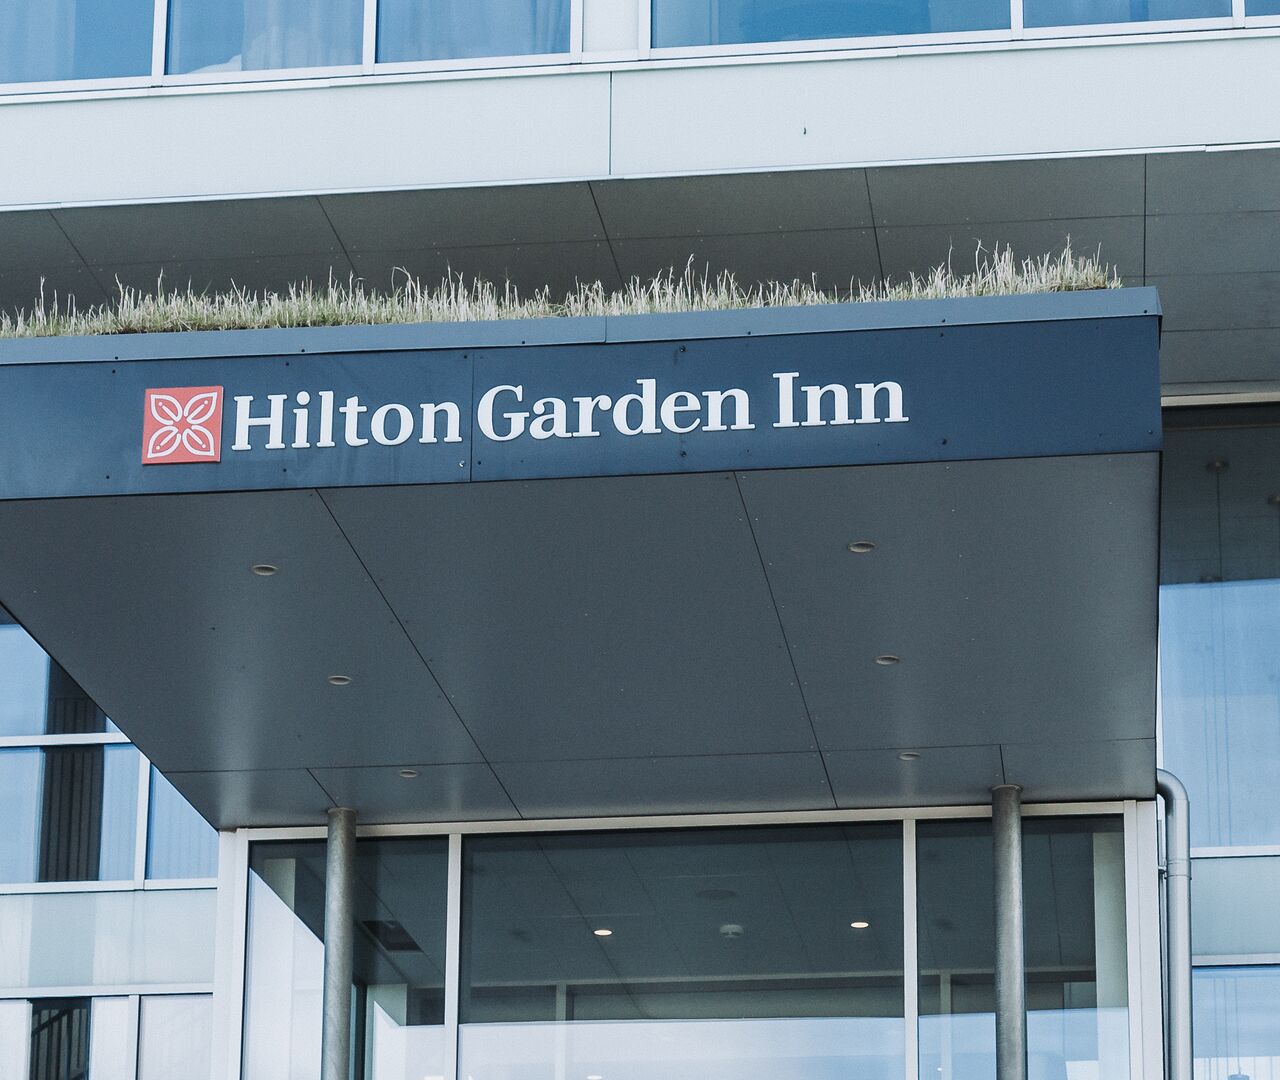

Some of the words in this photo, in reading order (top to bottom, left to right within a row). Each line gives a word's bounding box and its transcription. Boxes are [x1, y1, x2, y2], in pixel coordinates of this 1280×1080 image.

[231, 390, 463, 451] Hilton
[476, 378, 756, 441] Garden
[772, 371, 909, 428] Inn
